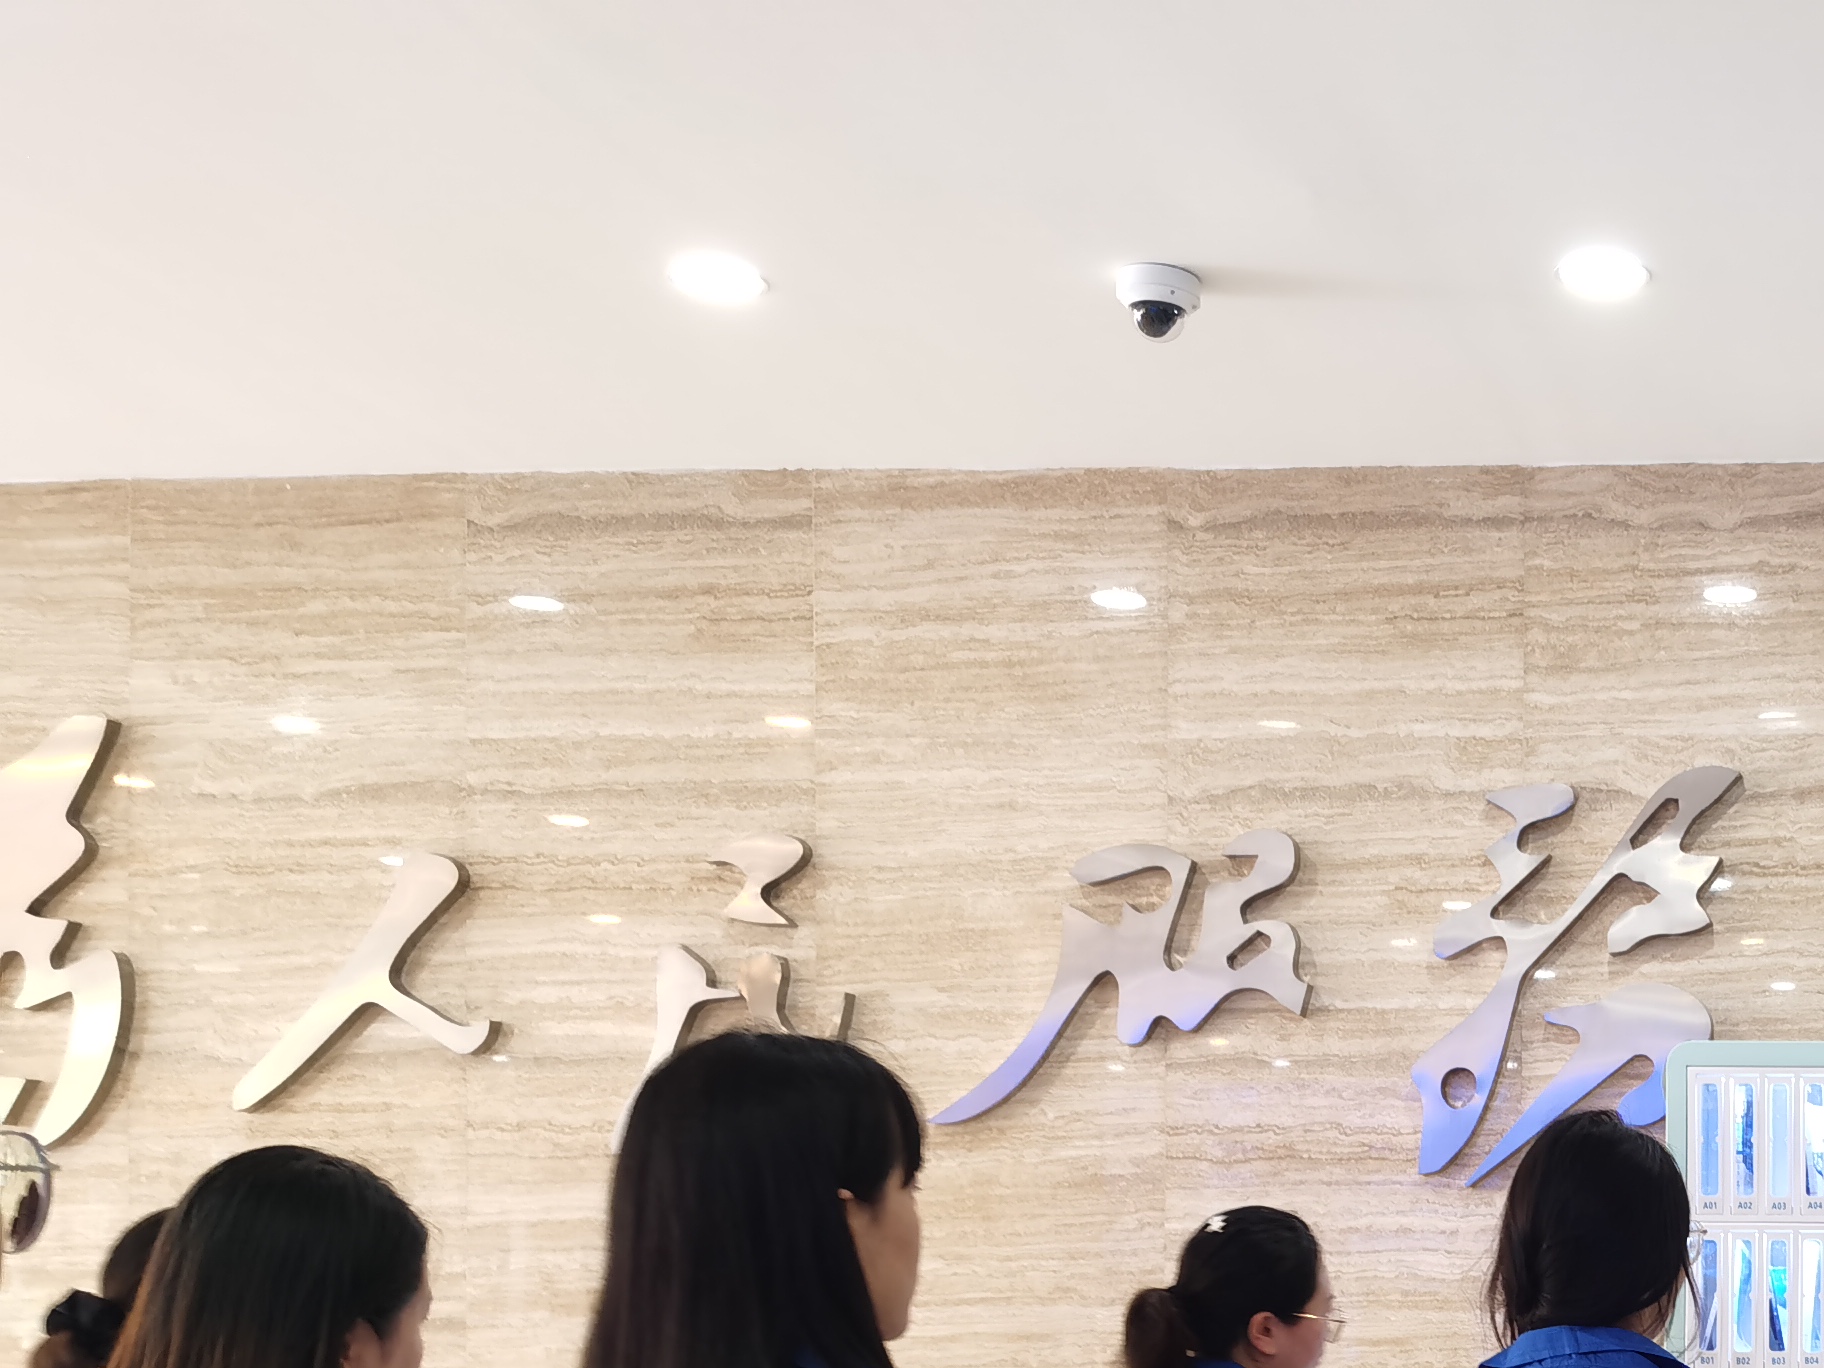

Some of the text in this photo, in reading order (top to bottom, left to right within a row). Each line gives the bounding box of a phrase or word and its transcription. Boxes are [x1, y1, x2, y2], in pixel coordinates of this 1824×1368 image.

[1702, 1202, 1718, 1210] A01
[1737, 1202, 1753, 1210] A02
[1771, 1202, 1787, 1210] A03
[1807, 1202, 1823, 1210] A04
[1700, 1357, 1715, 1365] B01
[1736, 1357, 1751, 1365] B02
[1771, 1357, 1786, 1365] B03
[1804, 1357, 1819, 1365] B04
